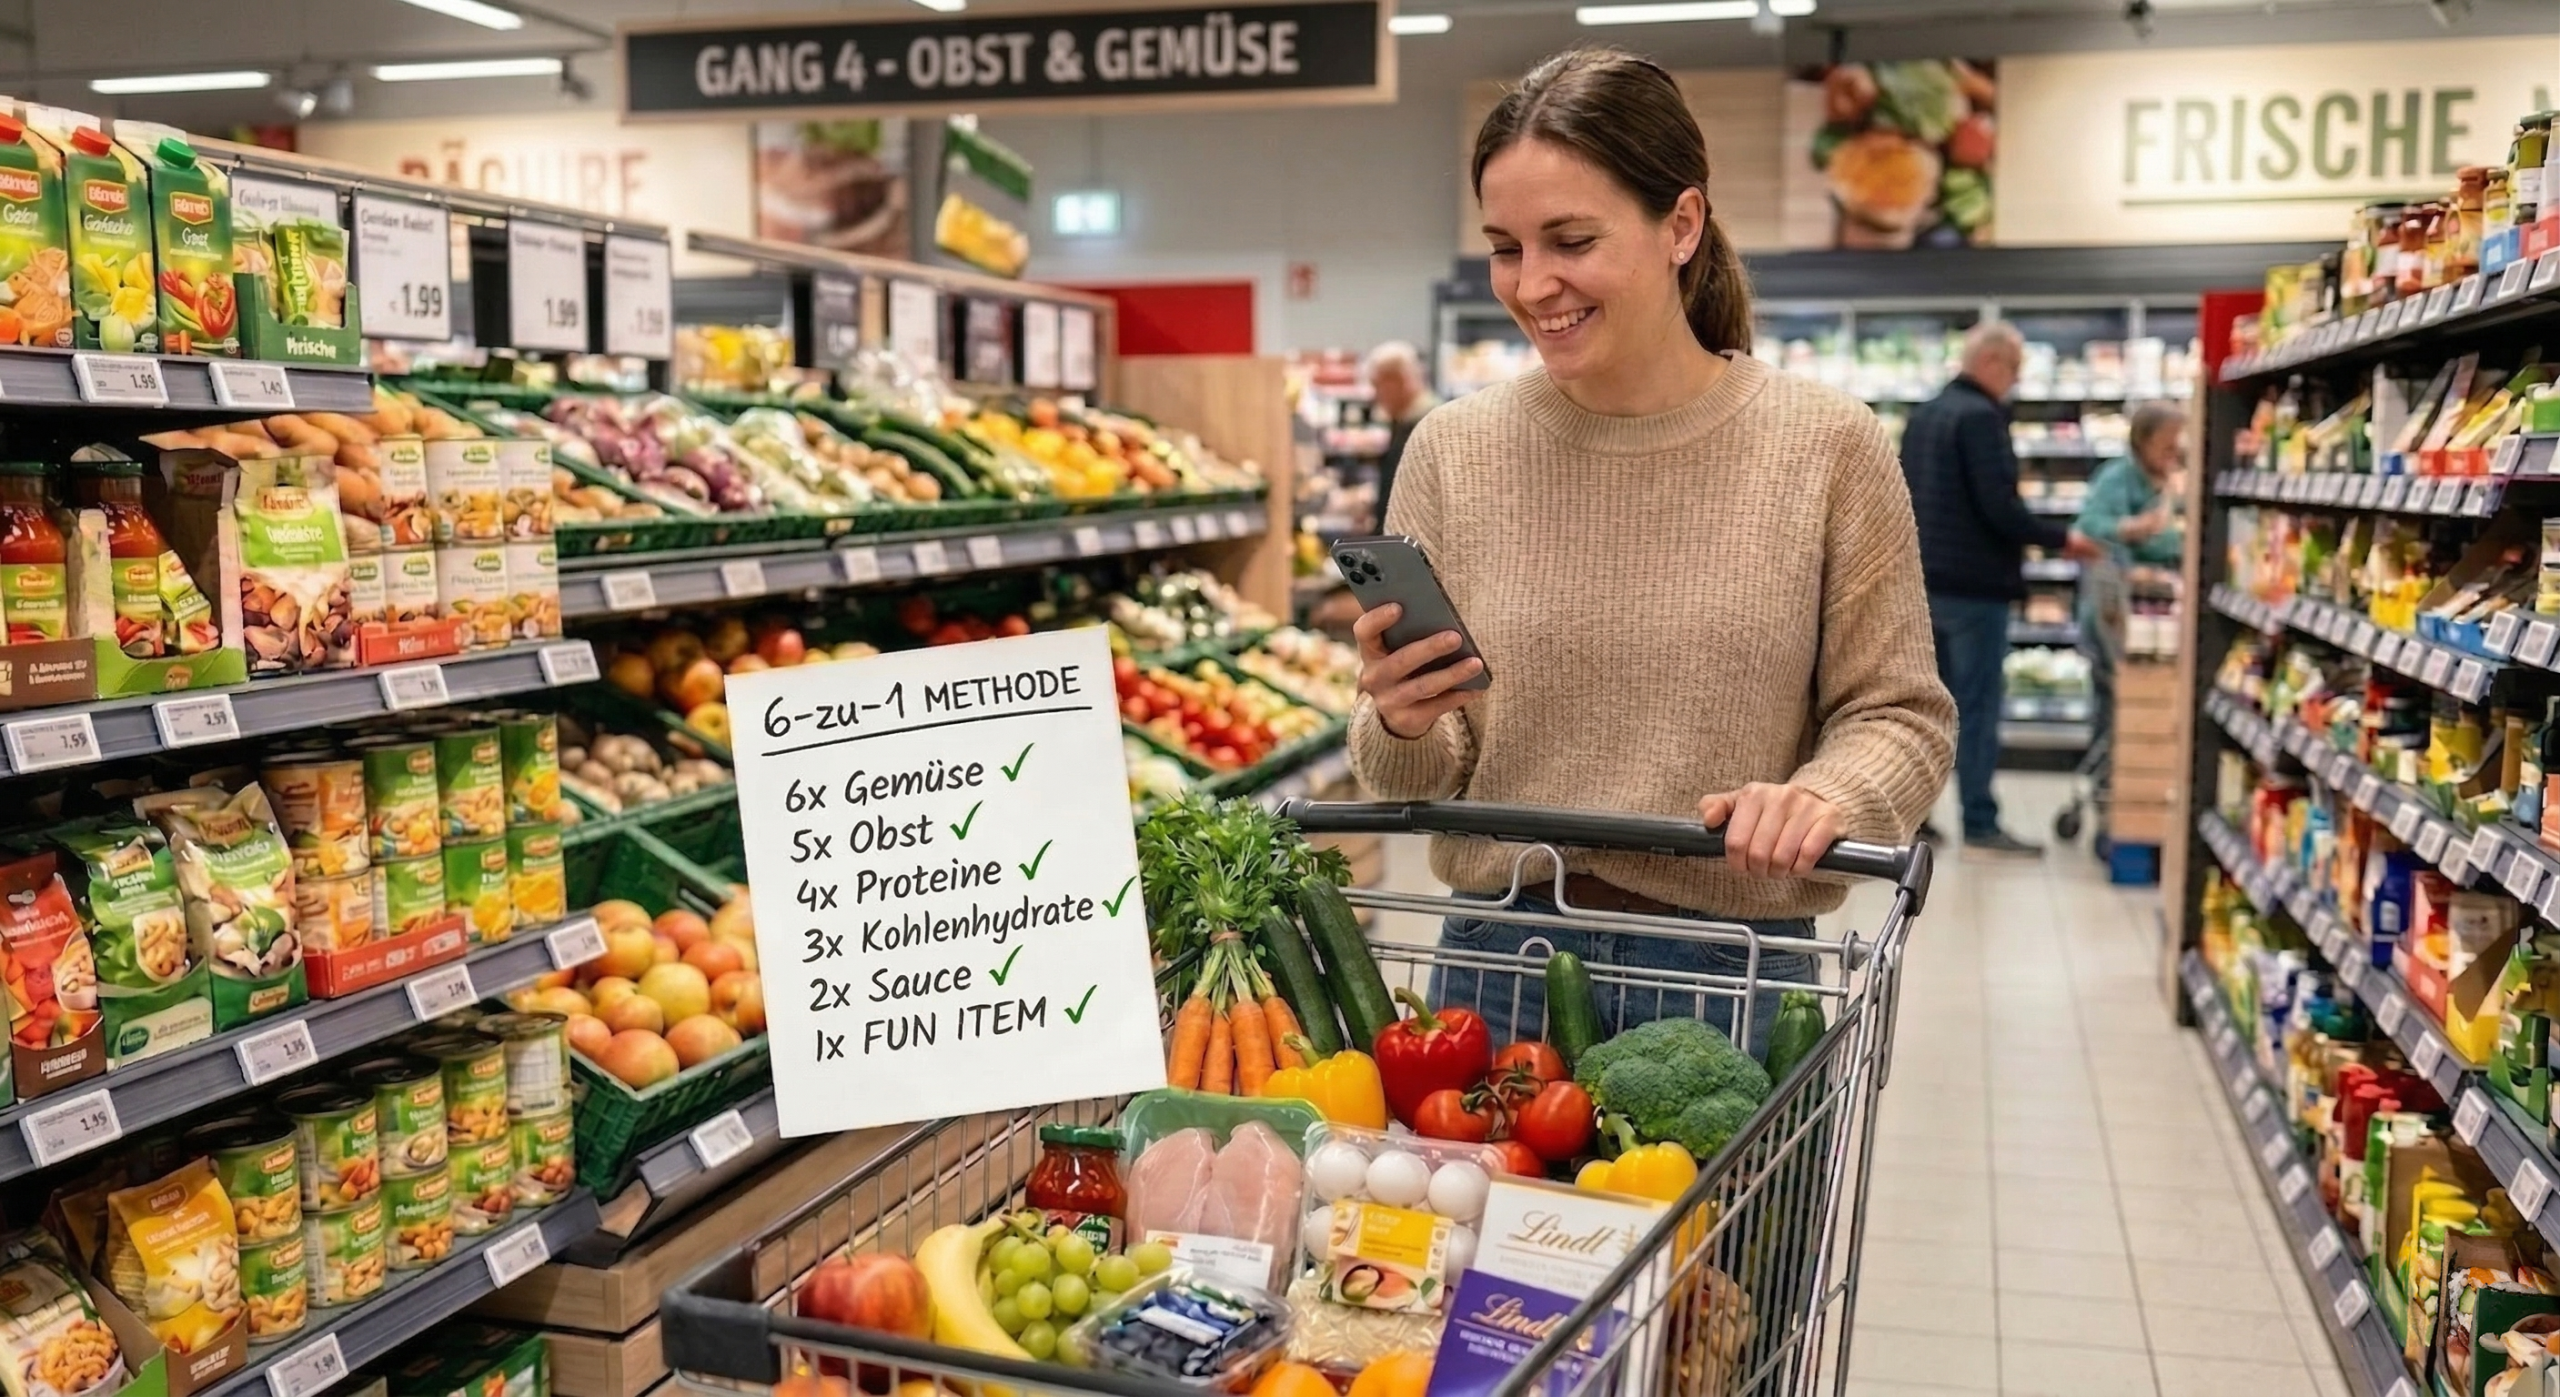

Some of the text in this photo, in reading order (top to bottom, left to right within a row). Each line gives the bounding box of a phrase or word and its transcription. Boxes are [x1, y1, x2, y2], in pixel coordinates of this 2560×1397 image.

[695, 15, 1299, 97] GANG 4 - OBST & GEMÜSE
[2123, 87, 2477, 184] FRISCHE
[402, 284, 443, 318] 1.99
[764, 665, 1082, 738] 6-zu-1 METHODE
[784, 760, 985, 814] 6x Gemüse
[789, 814, 934, 864] 5x Obst
[796, 858, 1003, 913] 4x Proteine
[802, 893, 1095, 964] 3x Kohlenhydrate
[808, 965, 973, 1013] 2x Sauce
[815, 996, 1048, 1063] 1x FUN ITEM
[1508, 1210, 1616, 1253] Lindt
